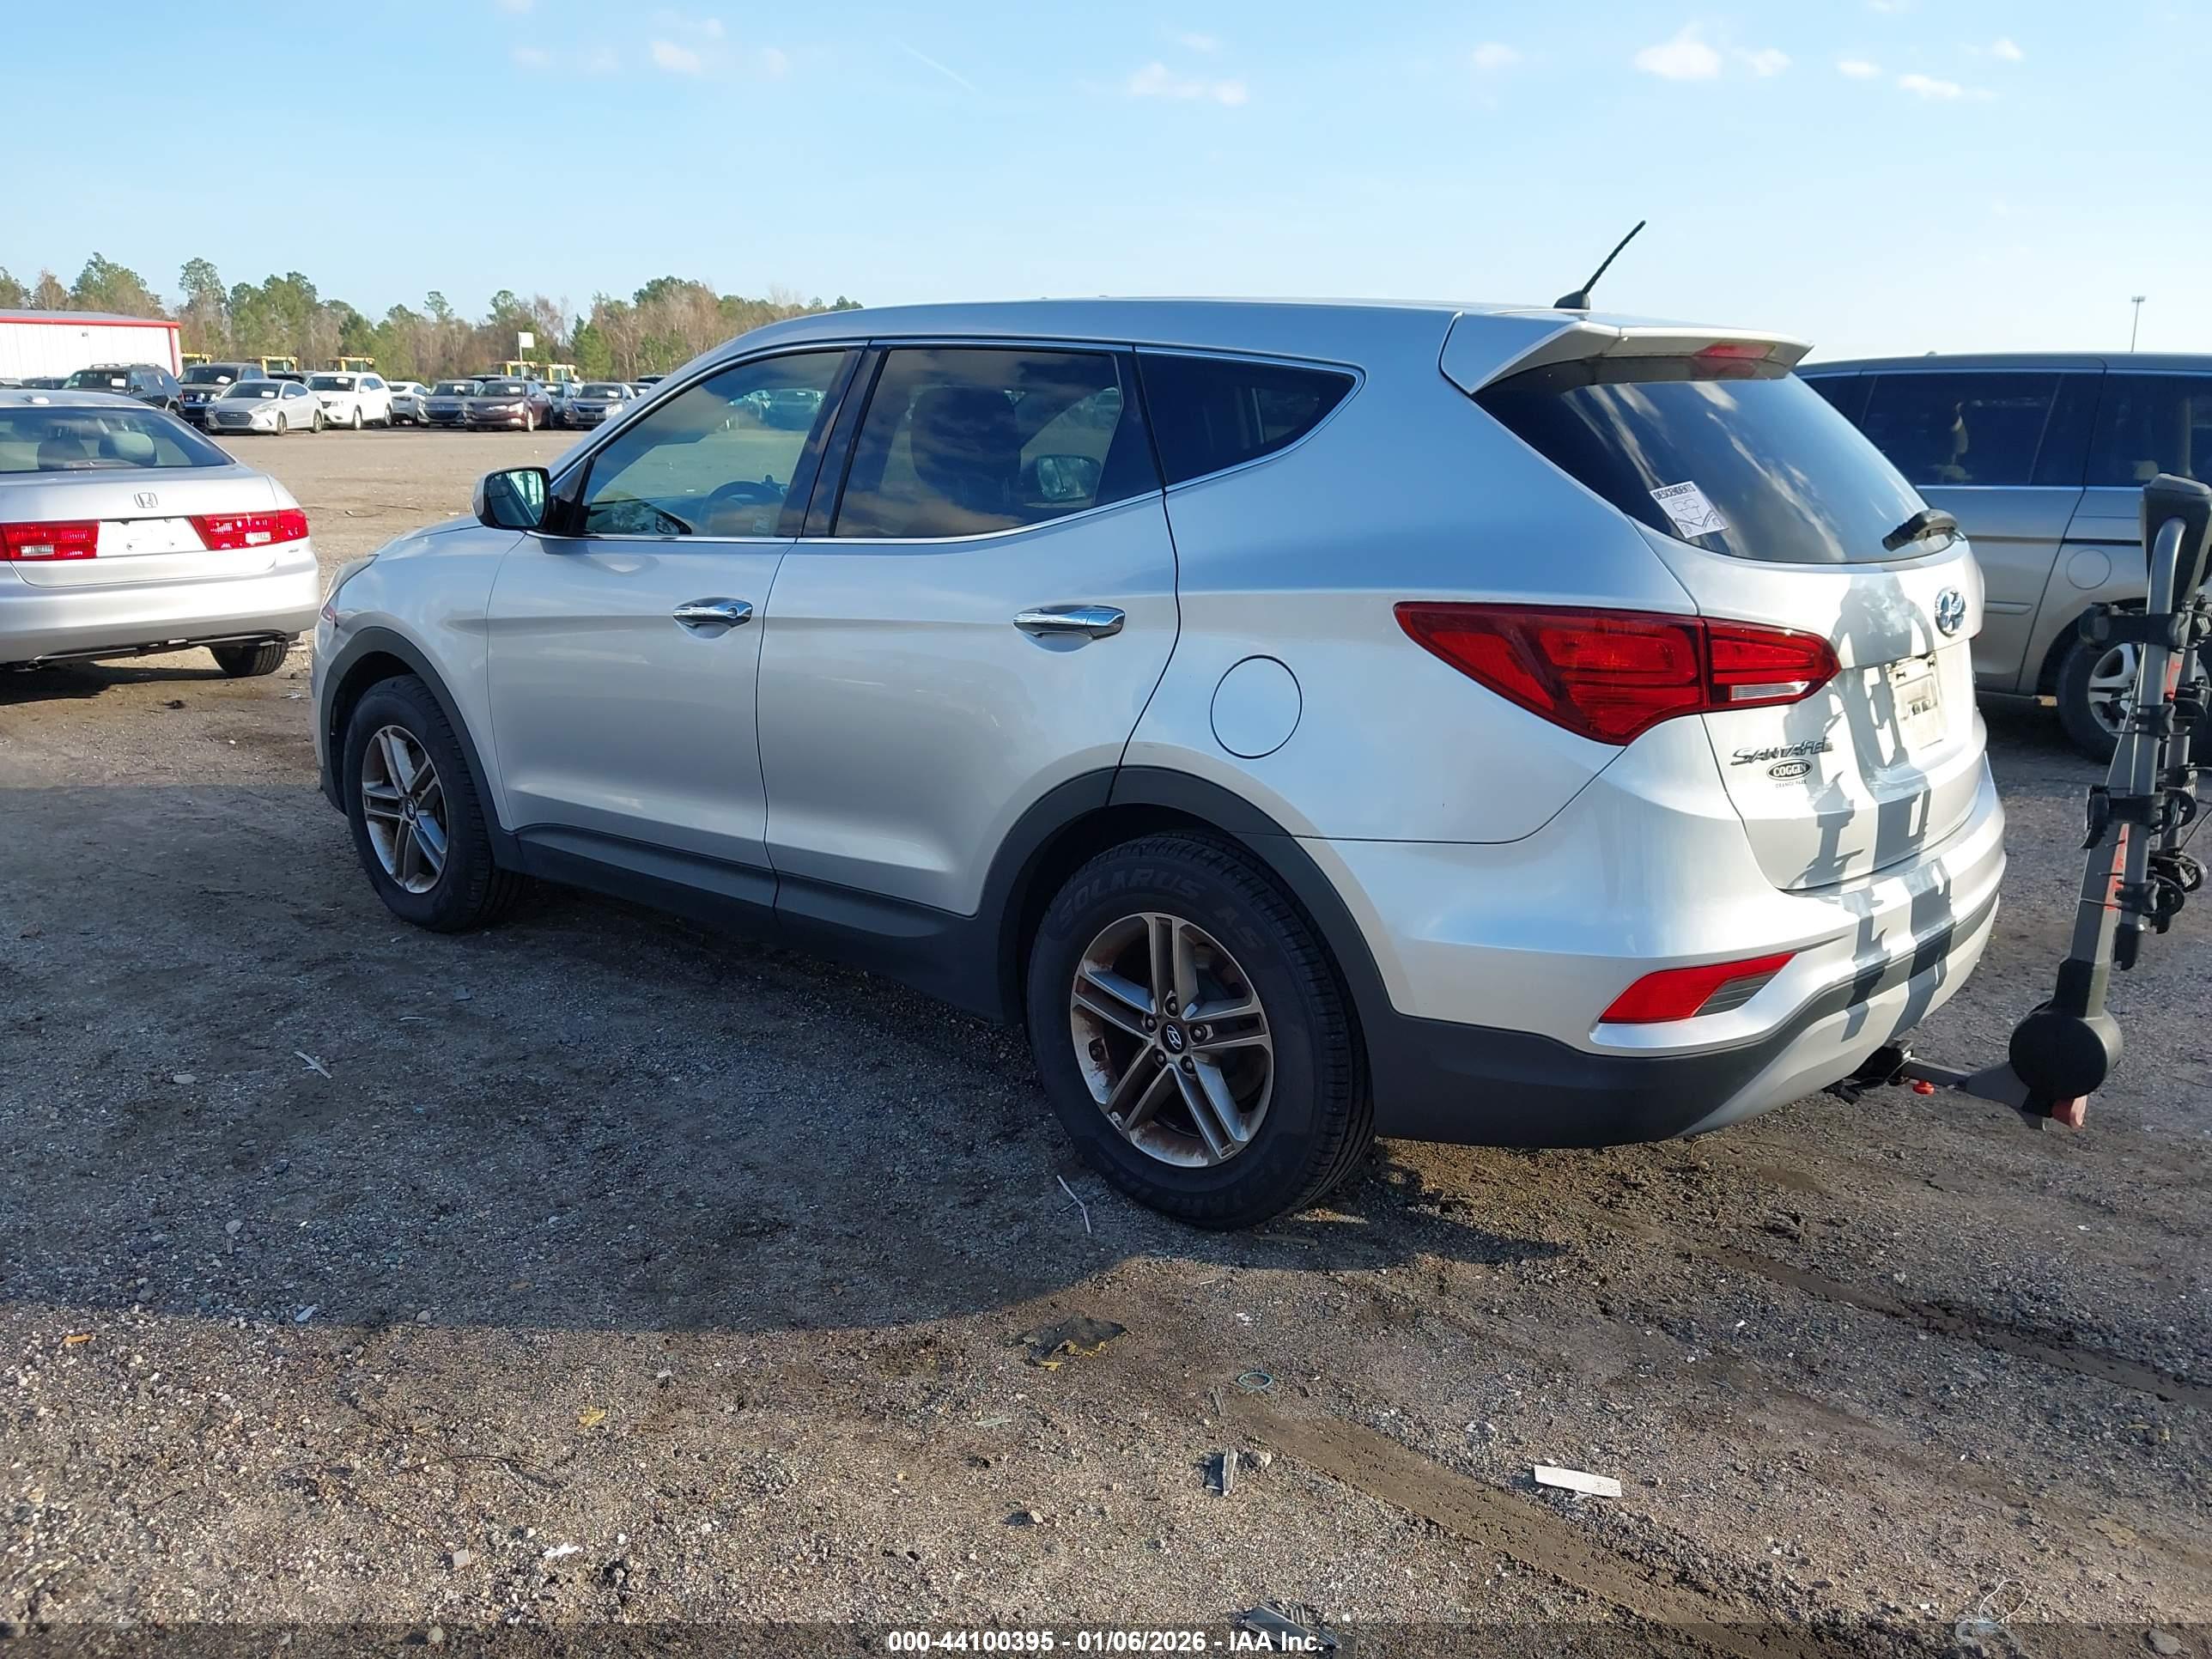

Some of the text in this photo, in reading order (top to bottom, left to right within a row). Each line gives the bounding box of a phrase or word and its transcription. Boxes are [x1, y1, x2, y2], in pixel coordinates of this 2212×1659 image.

[1653, 483, 1697, 501] DESCENDENTS
[1772, 763, 1807, 777] COGGIN
[1059, 868, 1204, 927] SOLARUS
